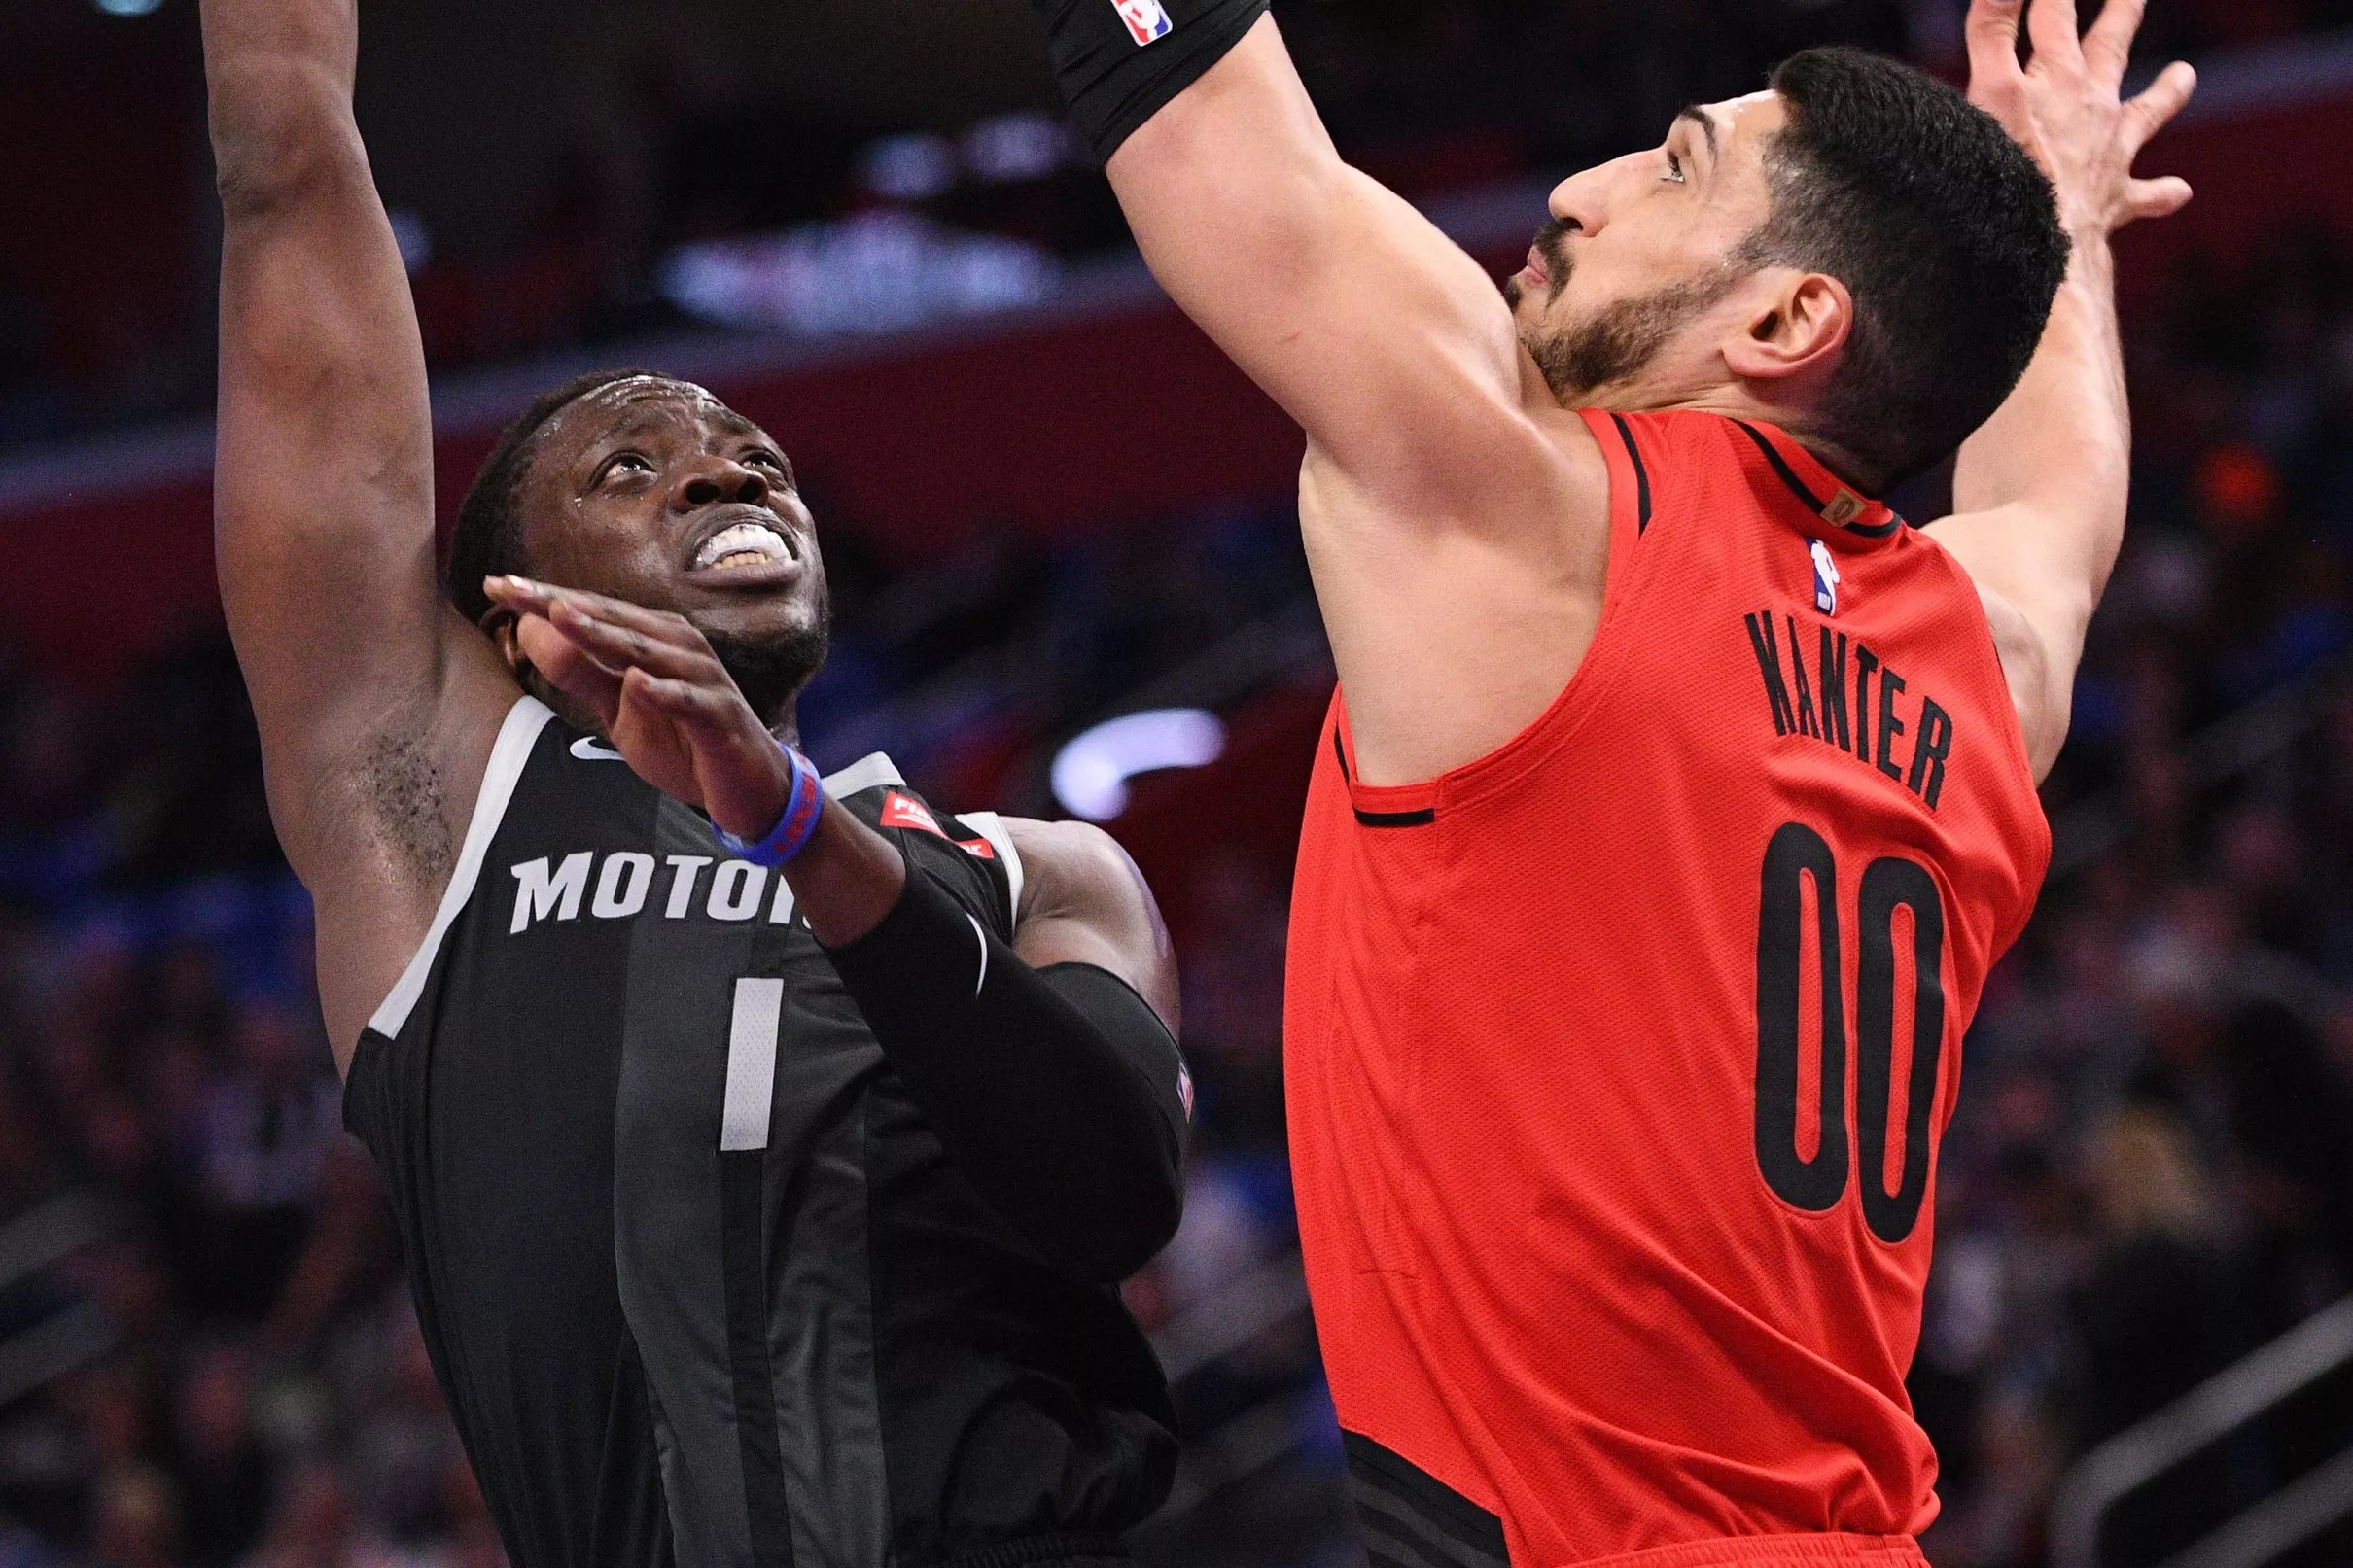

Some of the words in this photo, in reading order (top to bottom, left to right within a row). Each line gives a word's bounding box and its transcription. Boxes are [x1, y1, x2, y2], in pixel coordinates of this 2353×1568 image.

[1744, 609, 1953, 812] KANTER
[720, 976, 784, 1151] 1
[1754, 821, 1945, 1243] 00
